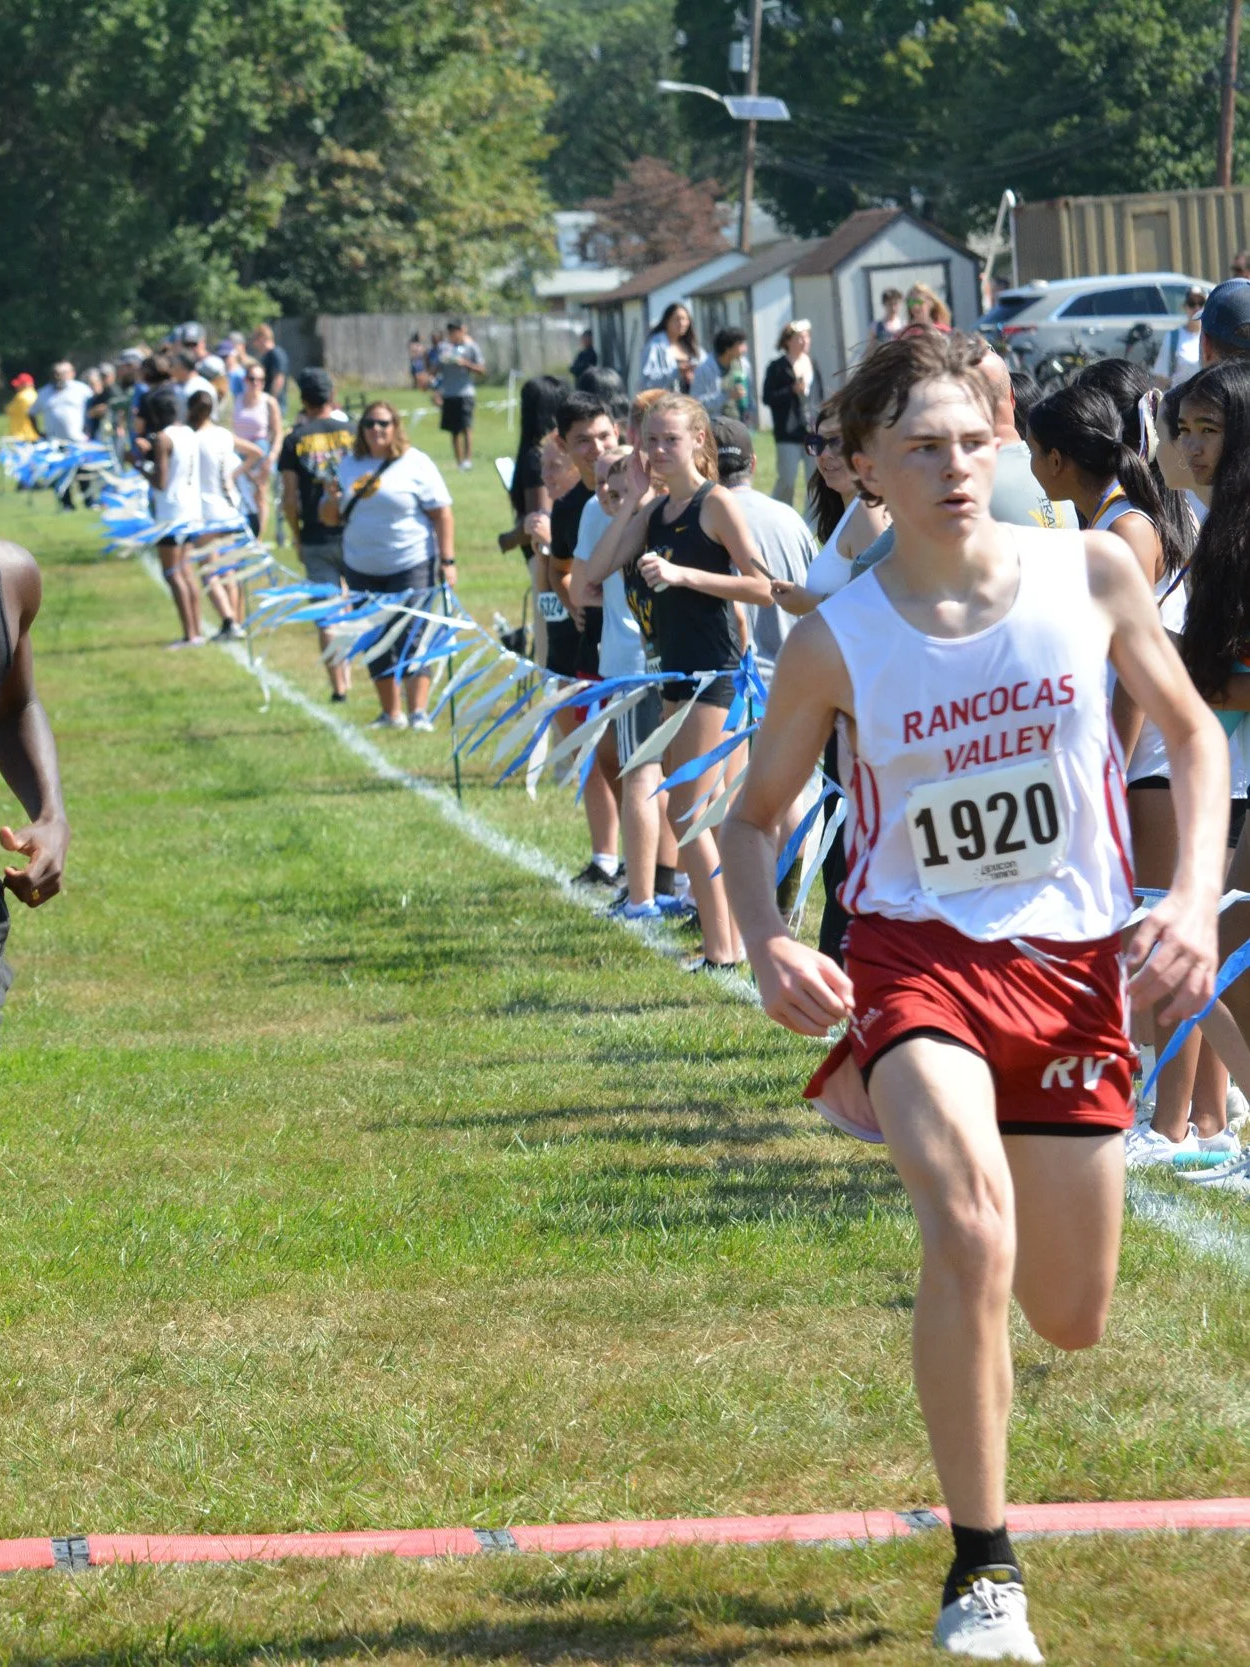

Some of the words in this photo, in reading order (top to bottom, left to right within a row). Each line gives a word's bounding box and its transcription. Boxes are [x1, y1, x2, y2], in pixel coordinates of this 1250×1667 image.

[903, 674, 1075, 744] RANCOCAS
[944, 723, 1055, 773] VALLEY
[914, 782, 1059, 868] 1920
[1041, 1053, 1117, 1091] RV
